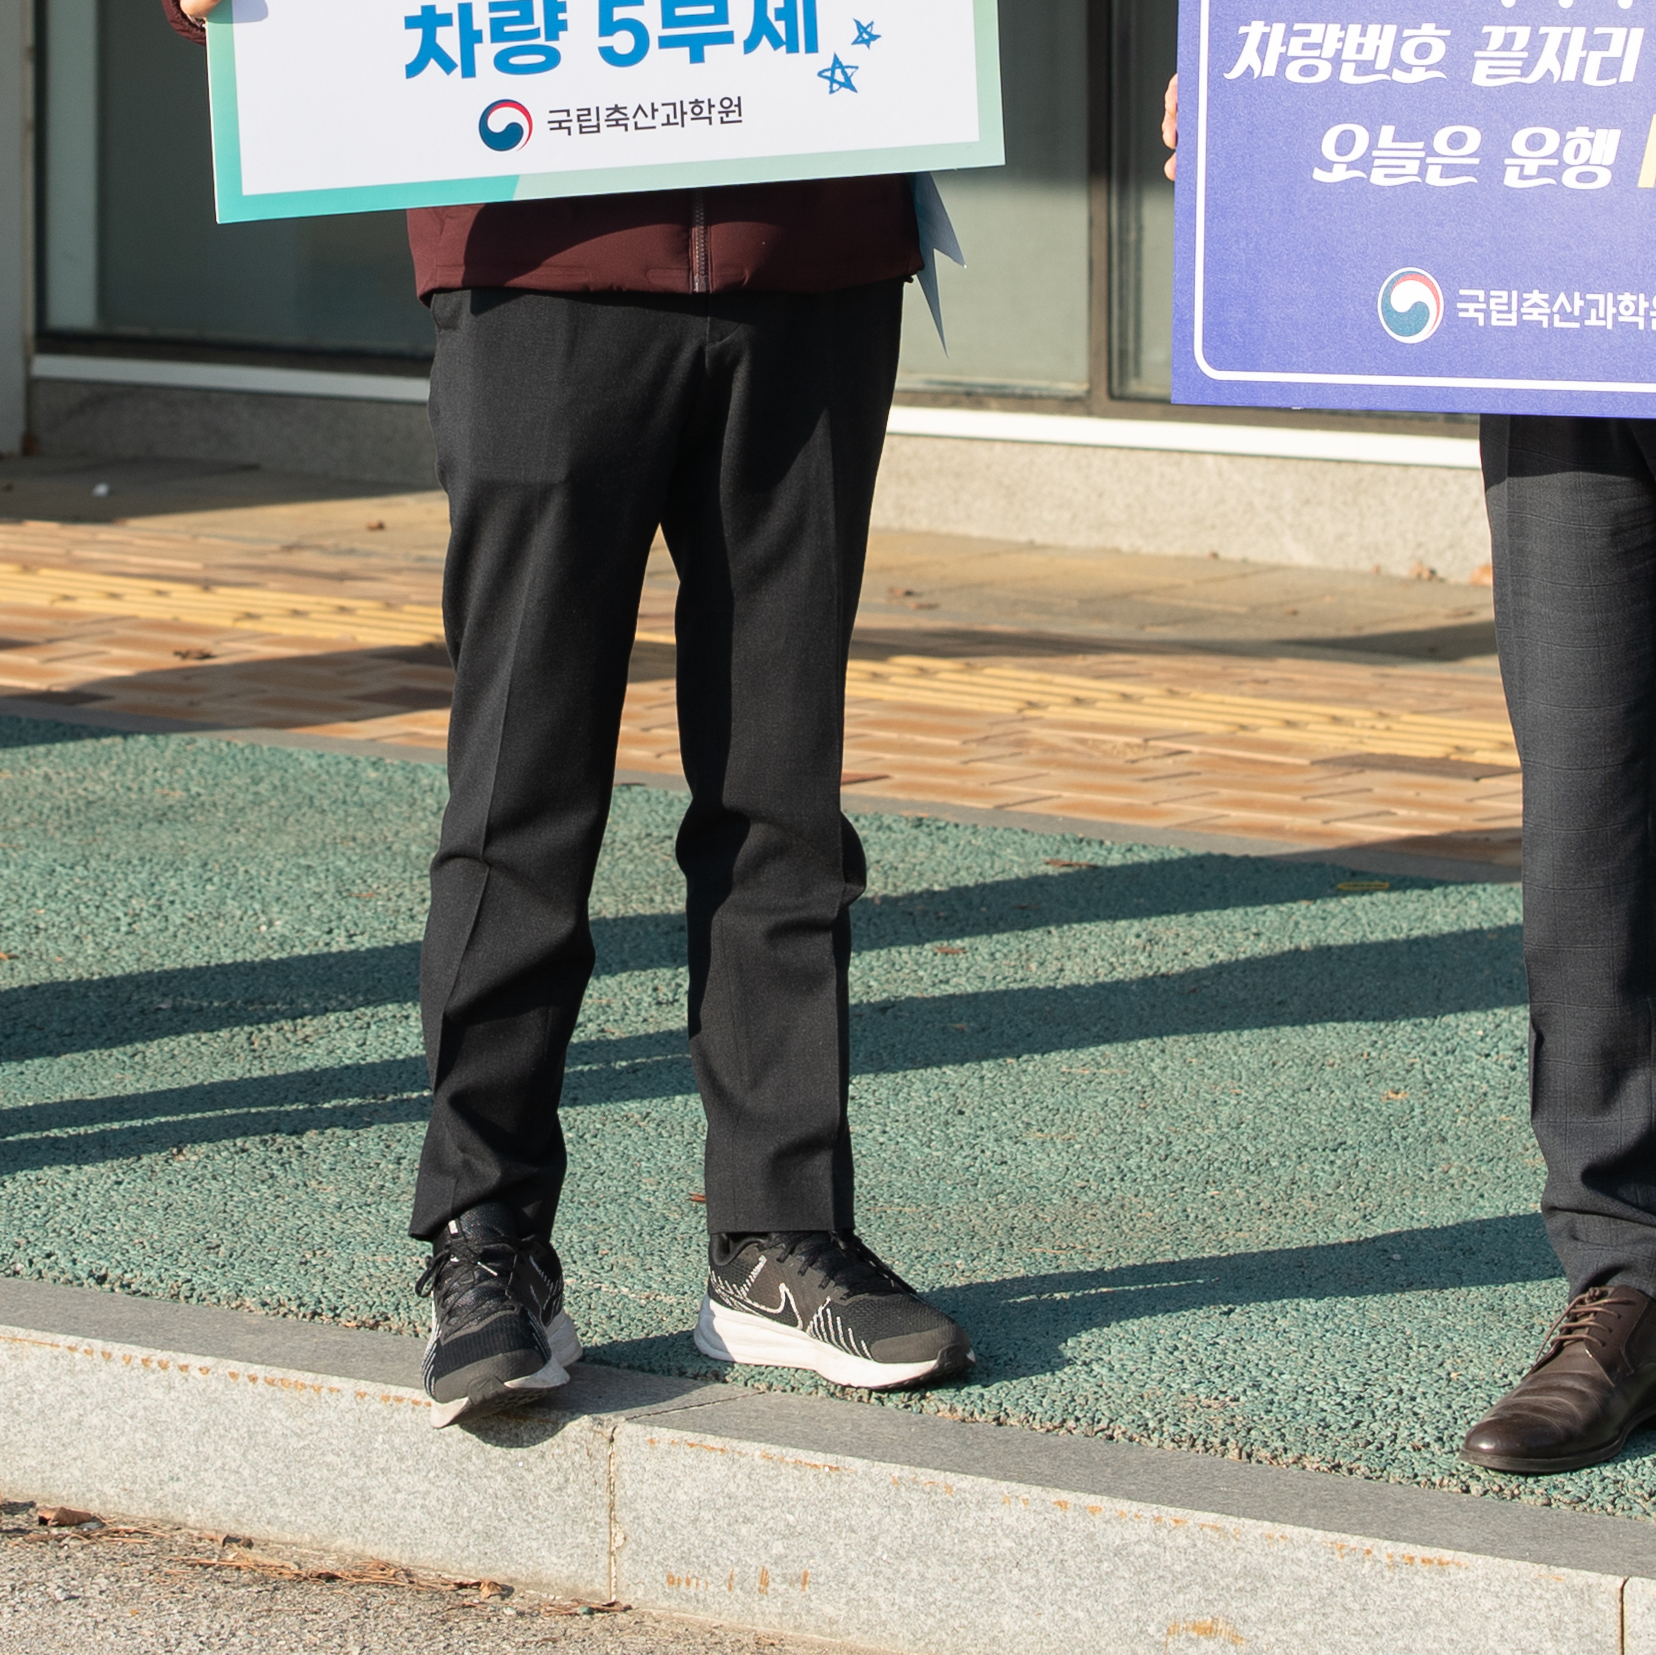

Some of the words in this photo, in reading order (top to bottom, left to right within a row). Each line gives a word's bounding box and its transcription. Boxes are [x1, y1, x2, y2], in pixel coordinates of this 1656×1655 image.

[1224, 21, 1450, 83] 차량번호
[1473, 26, 1644, 86] 끝자리
[547, 96, 743, 136] 국립축산과학원
[1313, 124, 1481, 186] 오늘은
[1504, 127, 1620, 189] 운행
